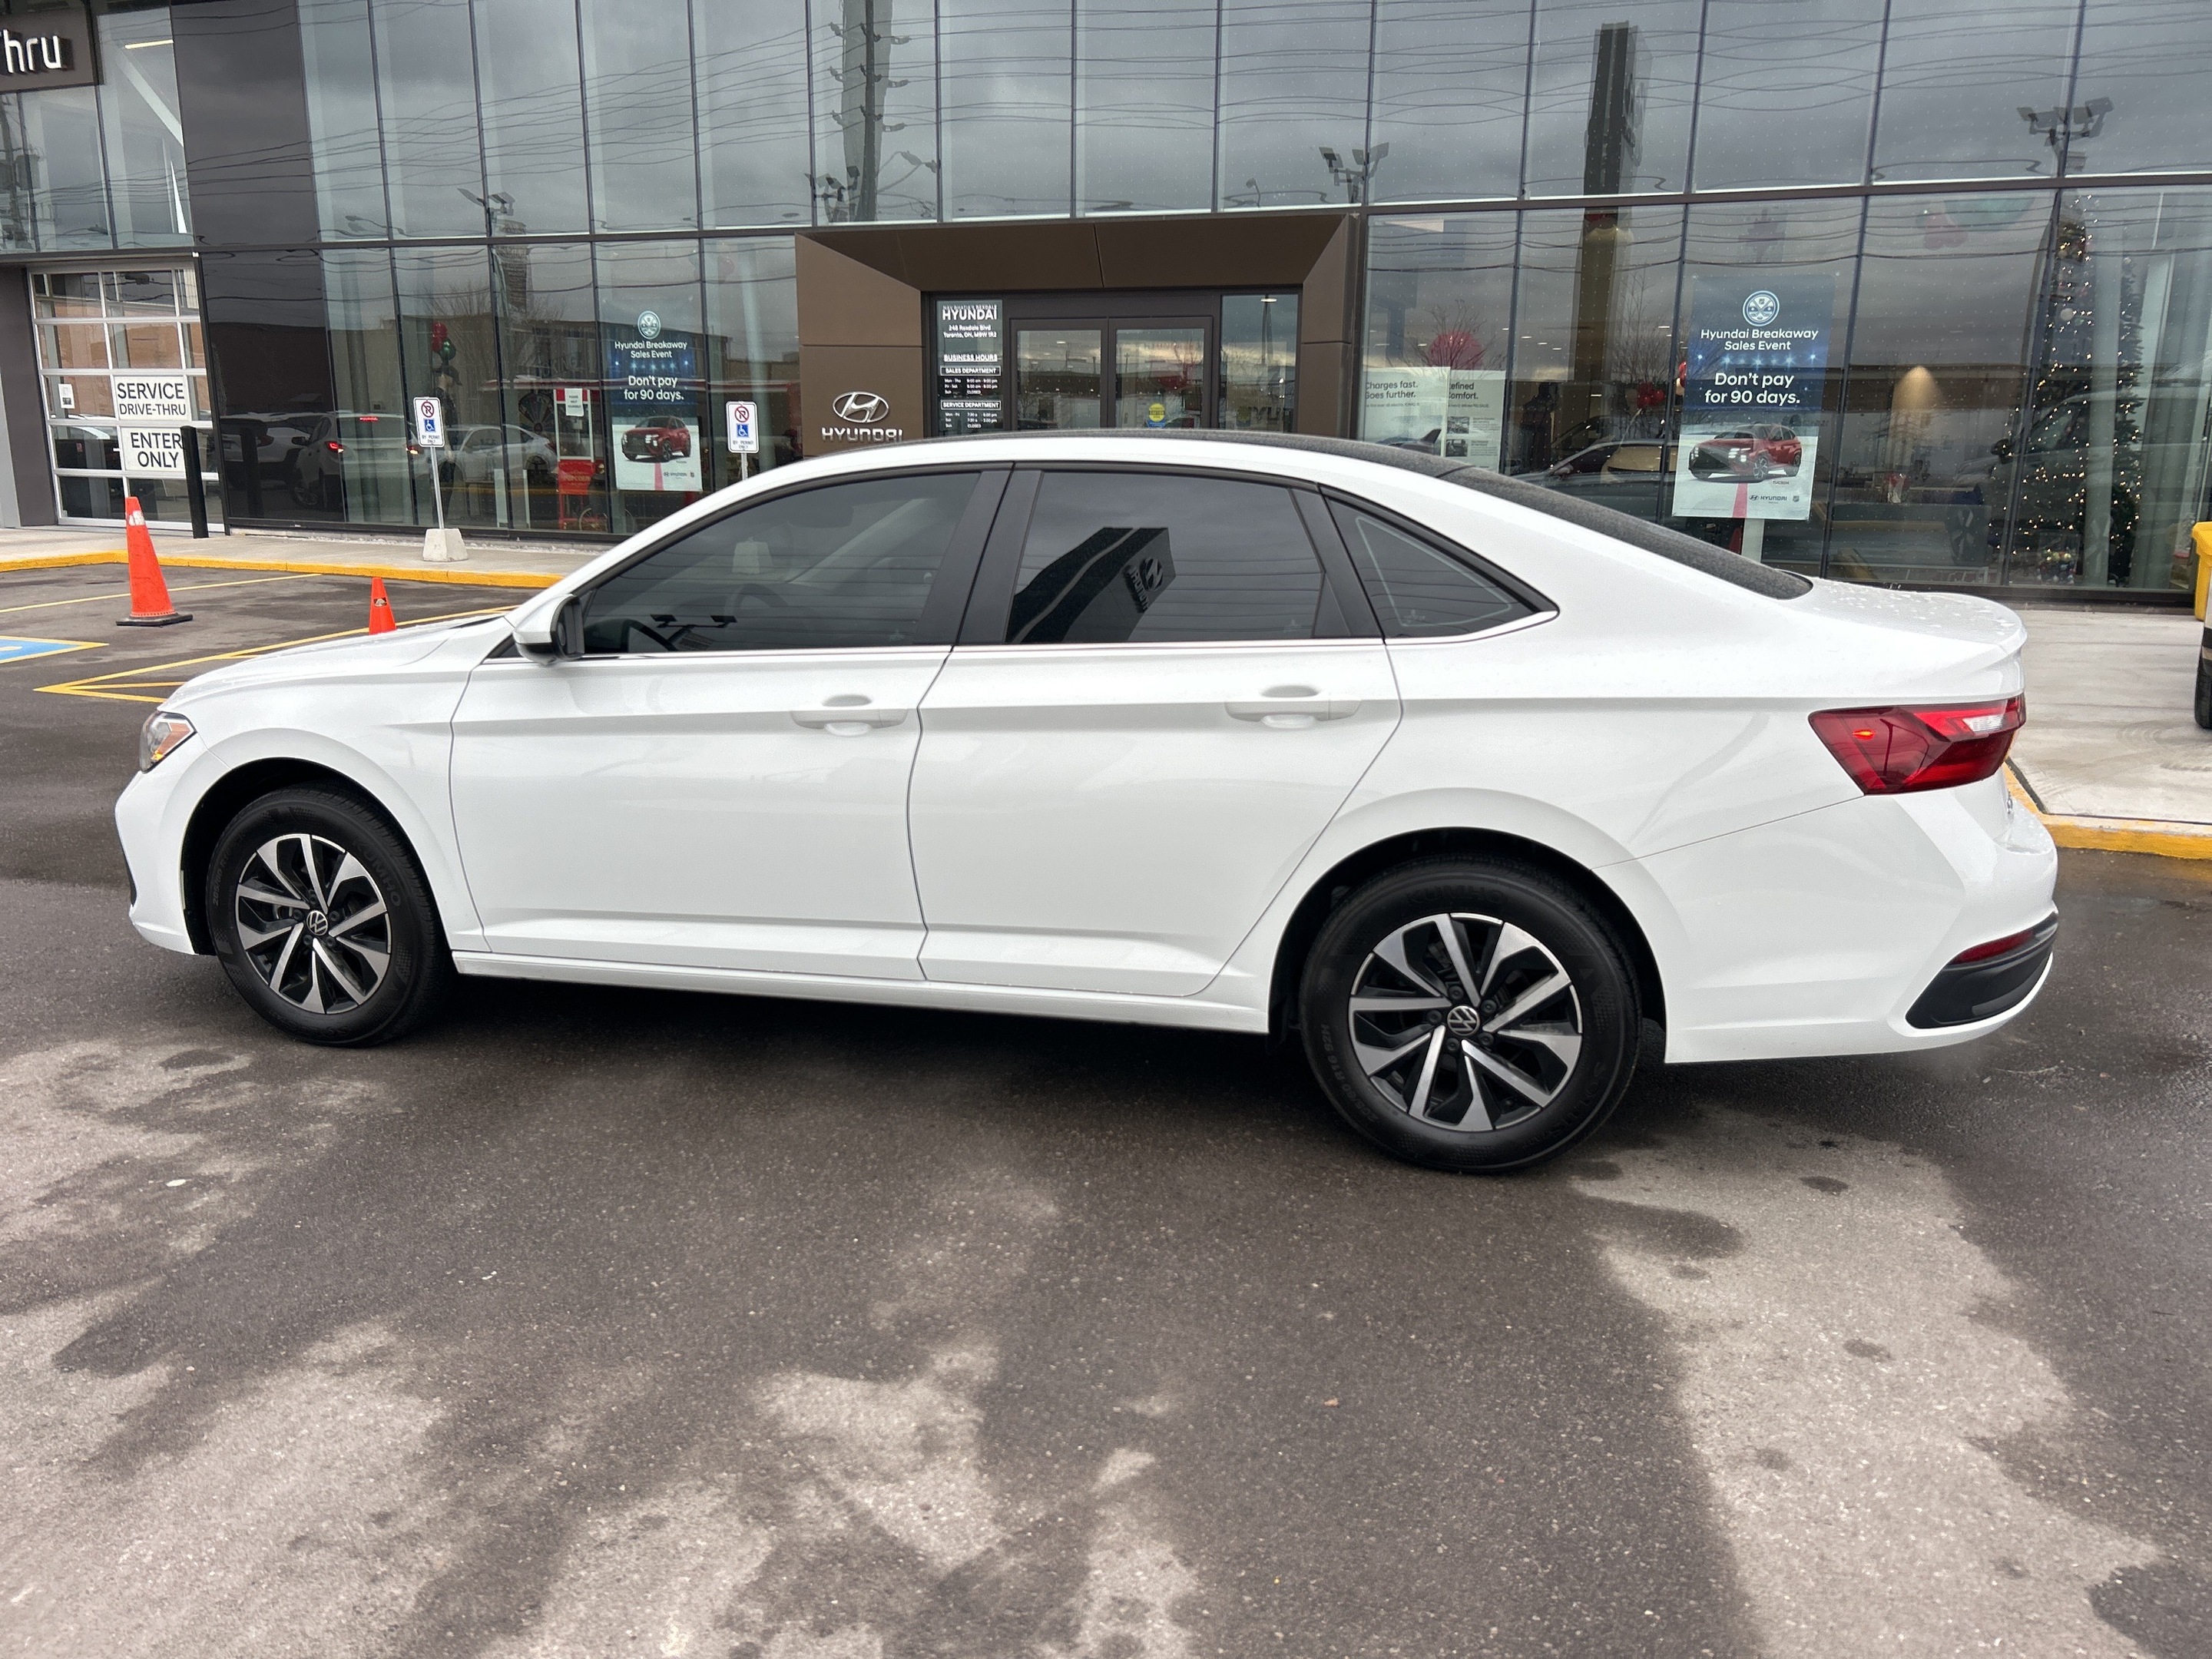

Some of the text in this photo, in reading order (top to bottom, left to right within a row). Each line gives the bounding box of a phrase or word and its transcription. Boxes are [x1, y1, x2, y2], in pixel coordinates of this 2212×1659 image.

[0, 28, 61, 74] hru
[942, 309, 997, 320] HYUNDAI
[1700, 329, 1818, 340] Hyundai Breakaway
[614, 340, 687, 350] Hyundai Breakaway
[1724, 341, 1791, 350] Sales Event
[628, 375, 677, 388] Don't pay
[1399, 380, 1418, 389] fast.
[1449, 382, 1475, 390] efined
[1714, 373, 1794, 388] Don't pay
[118, 382, 184, 399] SERVICE
[624, 389, 684, 402] for 90 days.
[1386, 390, 1416, 399] further.
[1704, 389, 1800, 406] for 90 days.
[119, 403, 186, 416] DRIVE-THRU
[131, 432, 184, 449] ENTER
[821, 427, 903, 442] HYUNDAI
[137, 451, 179, 468] ONLY
